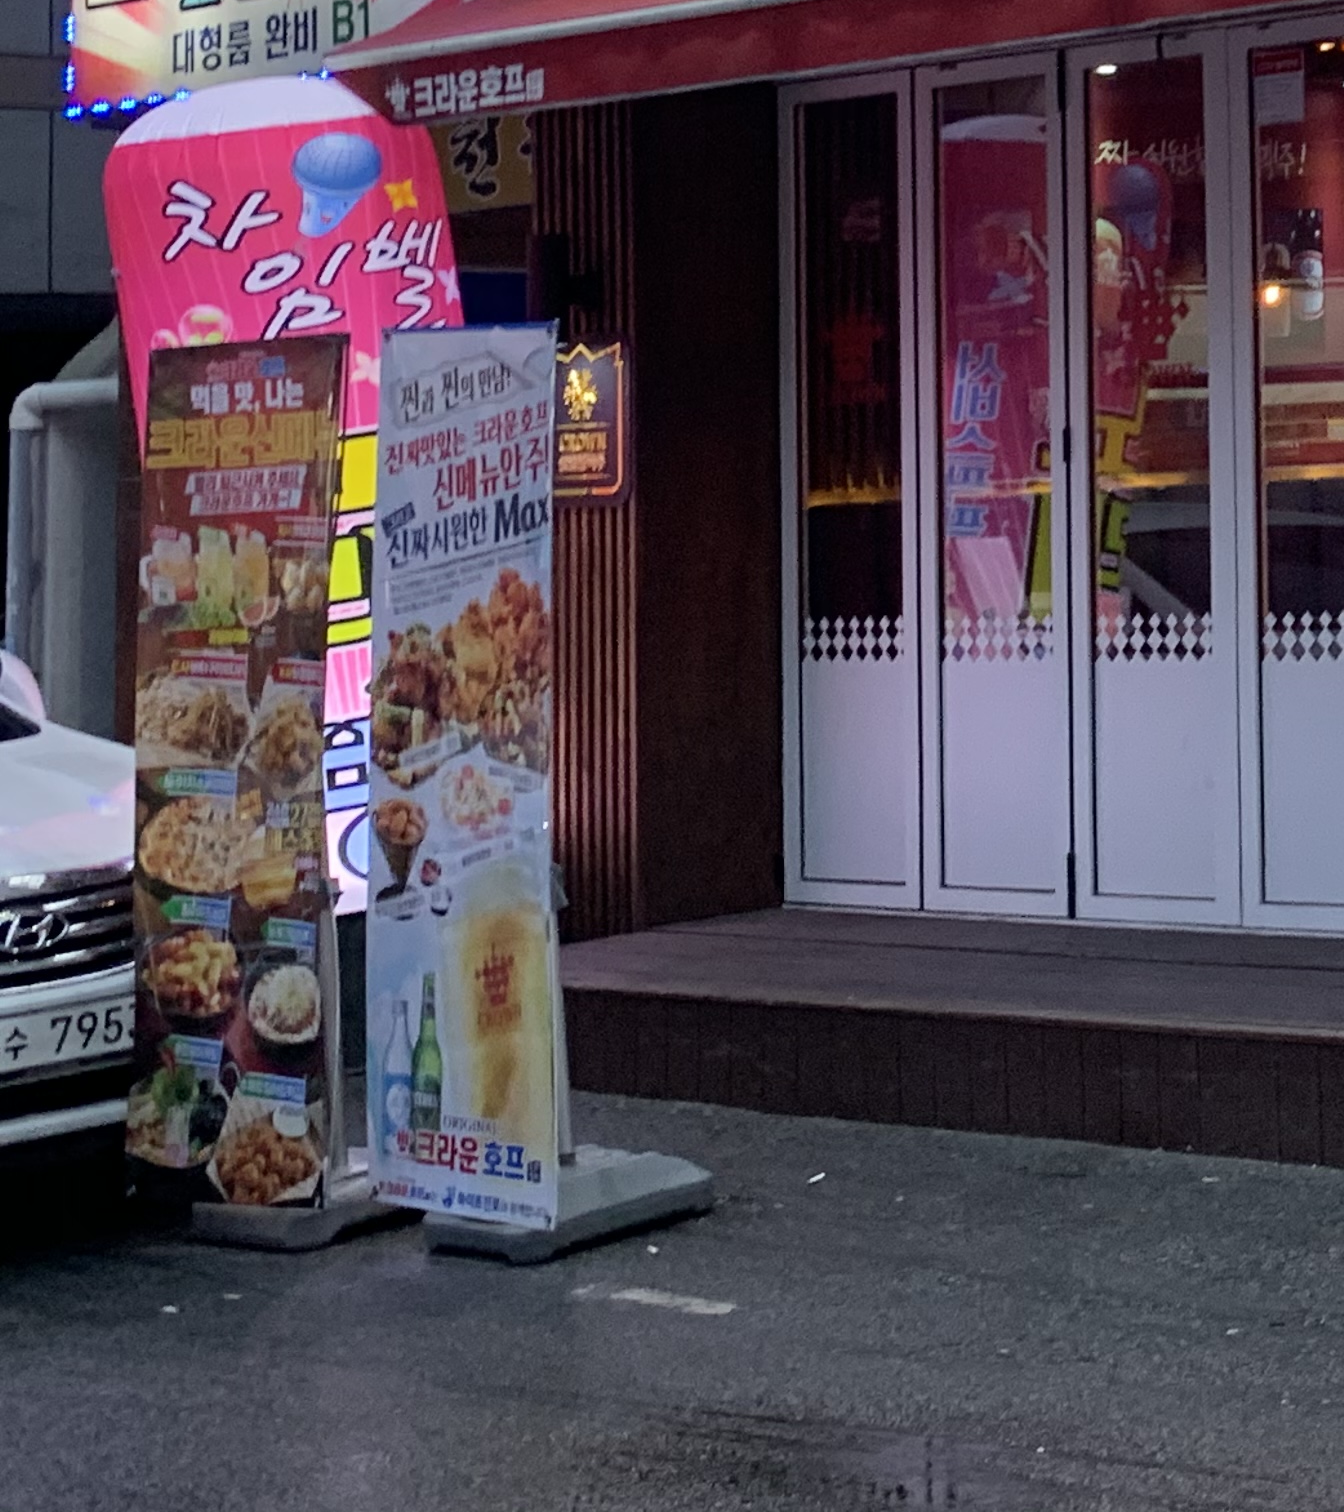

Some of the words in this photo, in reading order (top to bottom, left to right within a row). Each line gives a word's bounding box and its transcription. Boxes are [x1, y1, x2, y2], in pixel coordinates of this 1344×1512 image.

[172, 19, 251, 75] 대형룸
[265, 4, 319, 61] 완비
[414, 62, 527, 117] 크라운호프
[494, 492, 550, 544] Max
[51, 1001, 136, 1057] 795
